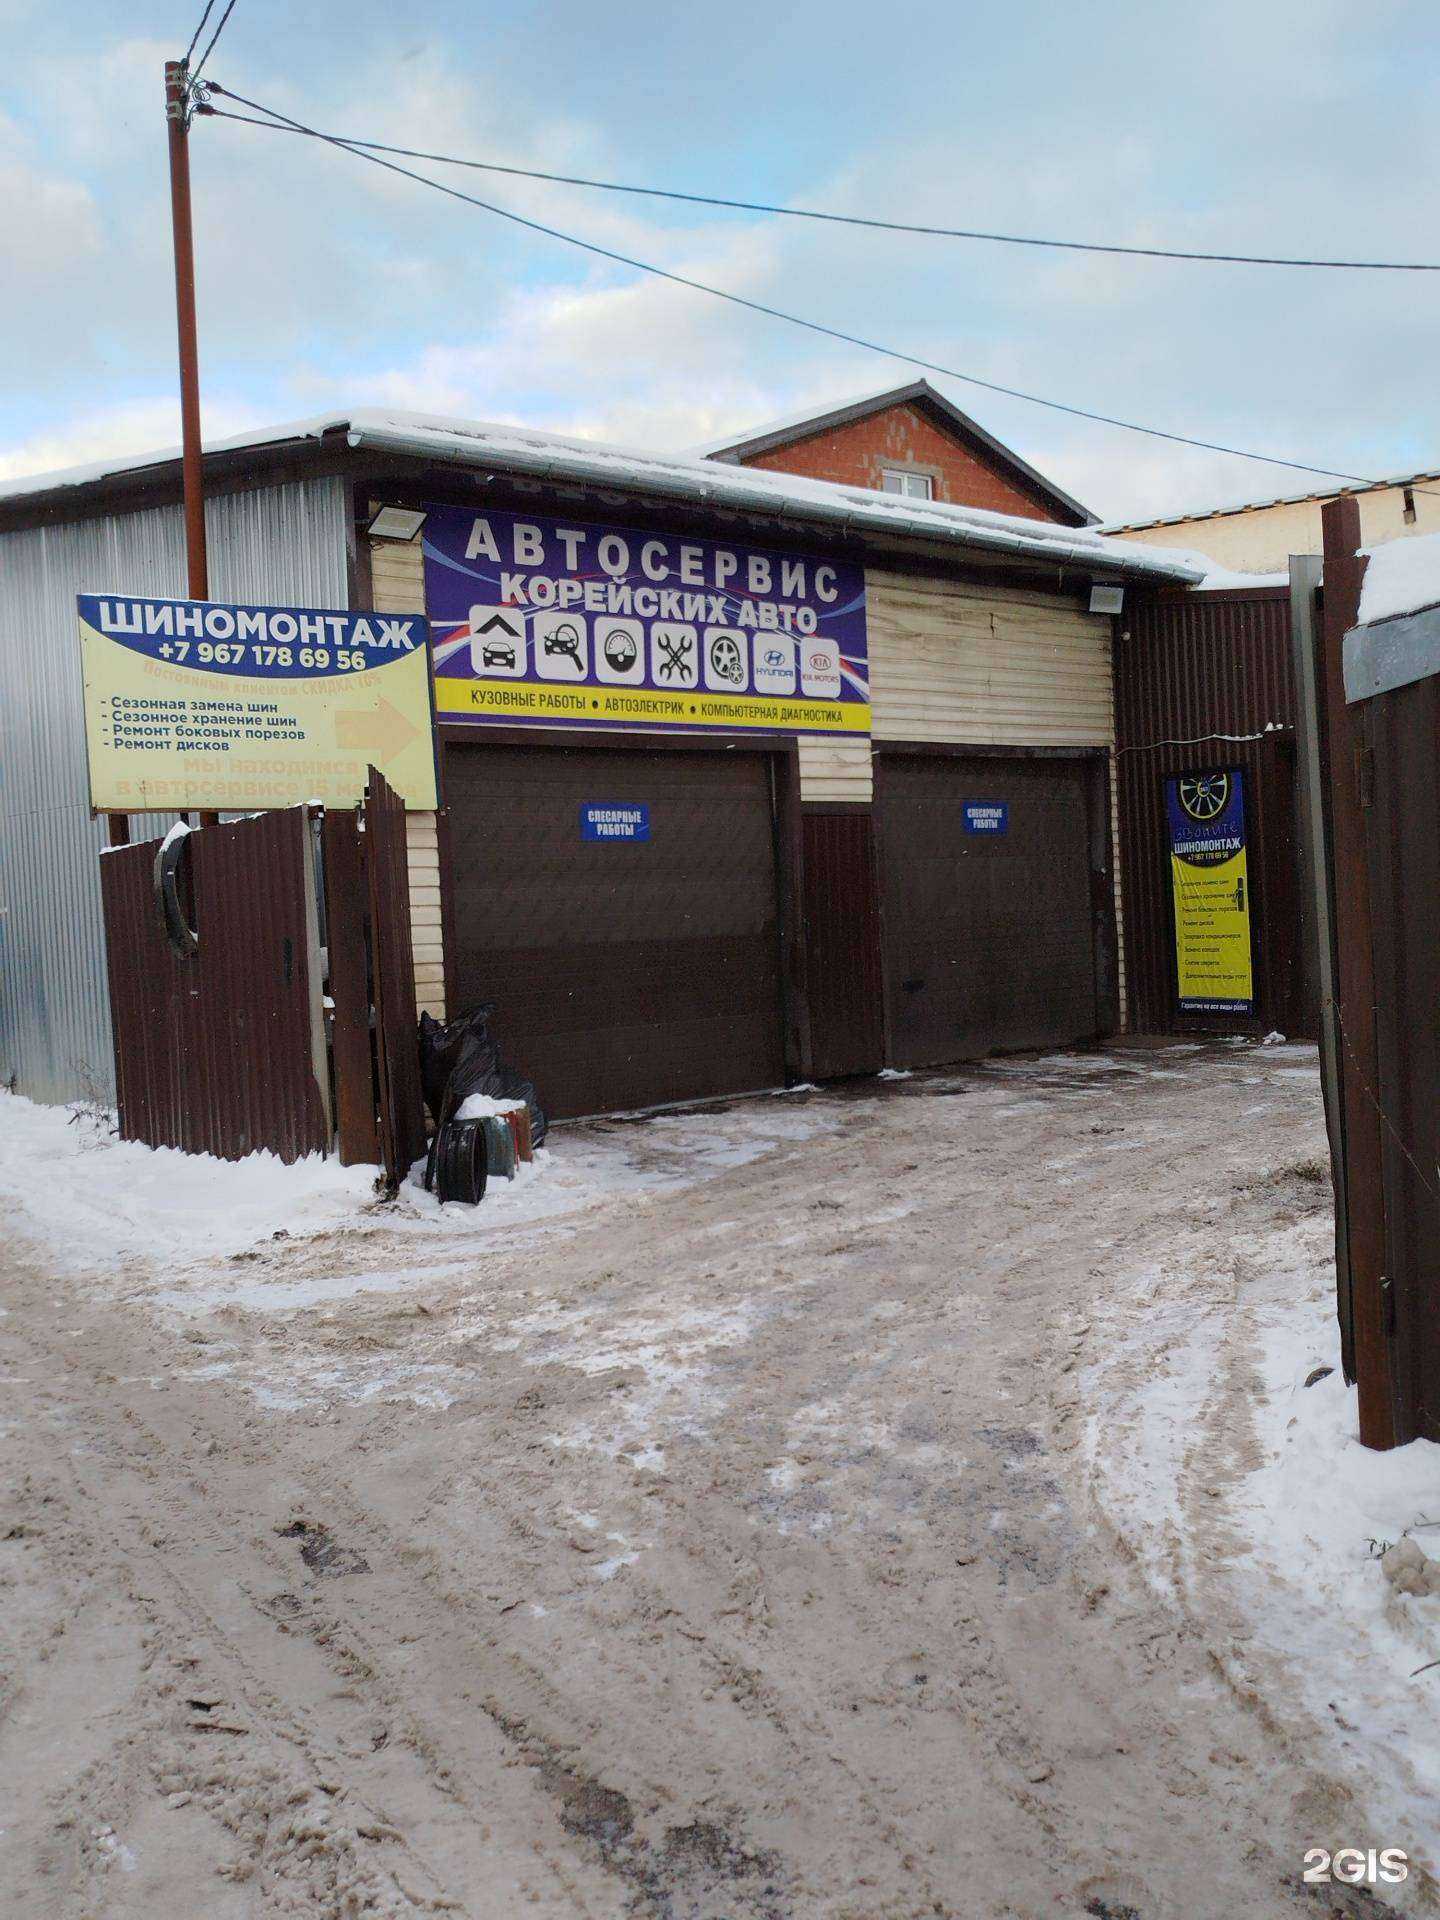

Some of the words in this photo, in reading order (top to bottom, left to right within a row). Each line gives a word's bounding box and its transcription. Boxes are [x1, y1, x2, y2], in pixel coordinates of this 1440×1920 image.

[464, 518, 839, 604] АВТОСЕРВИС
[500, 572, 729, 627] КОРЕЙСКИХ
[737, 600, 818, 634] АВТО
[99, 601, 415, 650] ШИНОМОНТАЖ
[158, 641, 190, 662] +7
[197, 643, 245, 664] 967
[251, 645, 293, 667] 178
[299, 647, 330, 669] 69
[337, 649, 366, 671] 56
[813, 658, 829, 668] KIA
[755, 667, 794, 678] HYUNDAI
[815, 674, 839, 683] MOTORS
[111, 696, 186, 710] Сезонная
[190, 699, 243, 712] замена
[247, 702, 278, 713] шин
[470, 690, 537, 708] КУЗОВНЫЕ
[539, 694, 586, 711] РАБОТЫ
[604, 698, 685, 715] АВТОЭЛЕКТРИК
[700, 703, 779, 720] КОМПЬЮТЕРНАЯ
[780, 708, 843, 723] ДИАГНОСТИКА
[112, 710, 187, 724] Сезонное
[192, 714, 262, 726] хранение
[267, 716, 297, 727] шин
[113, 724, 170, 737] Ремонт
[175, 725, 241, 739] боковых
[246, 729, 305, 741] порезов
[114, 738, 172, 750] Ремонт
[176, 740, 229, 752] дисков
[587, 810, 642, 823] СЛЕСАРНЫЕ
[596, 823, 634, 836] РАБОТЫ
[1174, 837, 1241, 854] ШИНОМОНТАЖ
